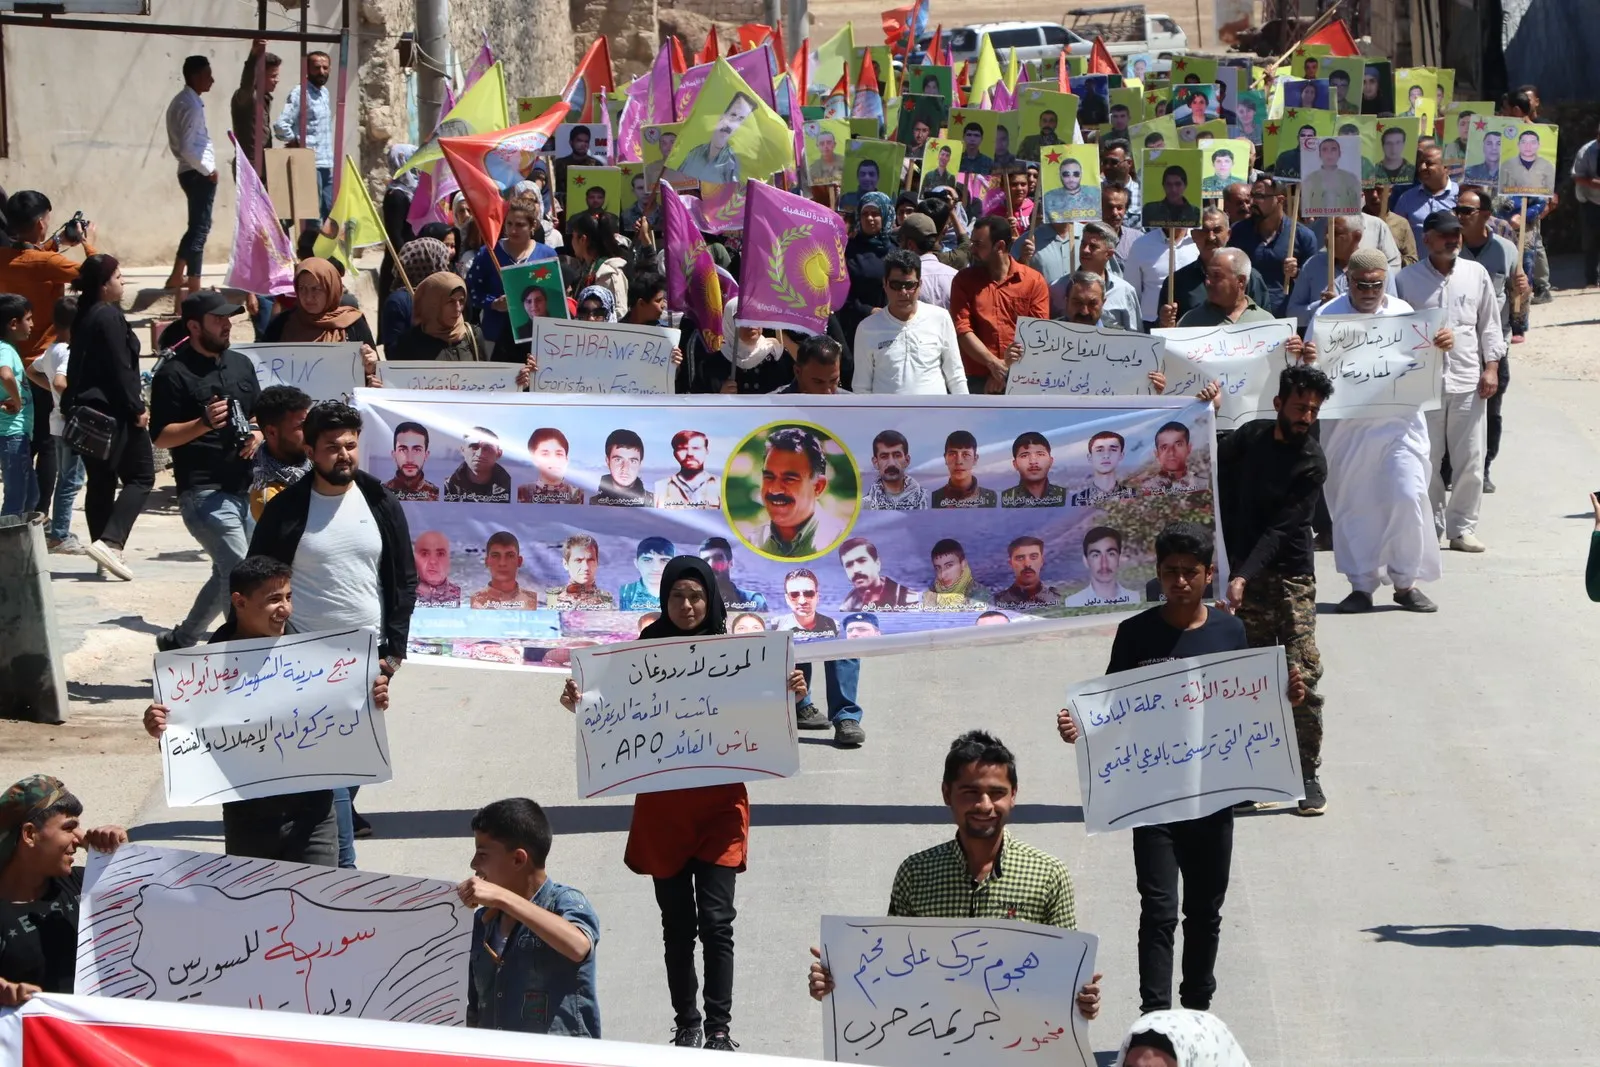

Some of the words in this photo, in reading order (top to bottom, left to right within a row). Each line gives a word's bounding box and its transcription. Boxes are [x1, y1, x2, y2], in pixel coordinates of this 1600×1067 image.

[1028, 329, 1066, 355] الذاتي
[1061, 338, 1106, 363] الدفاع
[1266, 340, 1280, 353] من
[1412, 321, 1432, 350] لا
[1106, 349, 1143, 368] واجب
[1228, 371, 1247, 395] نحن
[1084, 597, 1102, 607] دليل
[1104, 595, 1130, 605] الشهيد
[226, 655, 284, 697] الشهيد
[283, 660, 324, 692] مدينة
[326, 647, 357, 683] منبج
[628, 644, 706, 685] لأردوغان
[708, 646, 766, 678] الموت
[1134, 692, 1166, 714] جملة
[1222, 675, 1268, 701] الإدارة
[632, 692, 669, 721] الأمة
[675, 695, 719, 721] عاشت
[1089, 697, 1131, 727] المبادئ
[273, 708, 301, 764] أمام
[338, 709, 360, 737] لن
[664, 728, 713, 759] القائد
[716, 730, 759, 756] عاش
[1136, 741, 1170, 775] بالوعي
[1173, 734, 1218, 766] ترسخت
[1218, 723, 1243, 762] التي
[1244, 721, 1281, 770] والقيم
[1098, 742, 1137, 784] المجتمعي
[264, 925, 376, 975] سورية
[885, 931, 931, 977] على
[936, 929, 989, 982] تركي
[853, 928, 884, 1009] مخيم
[983, 951, 1040, 1011] هجوم
[843, 1007, 908, 1057] حرب
[907, 1002, 1002, 1056] جريمة
[1003, 1020, 1065, 1052] مخمور
